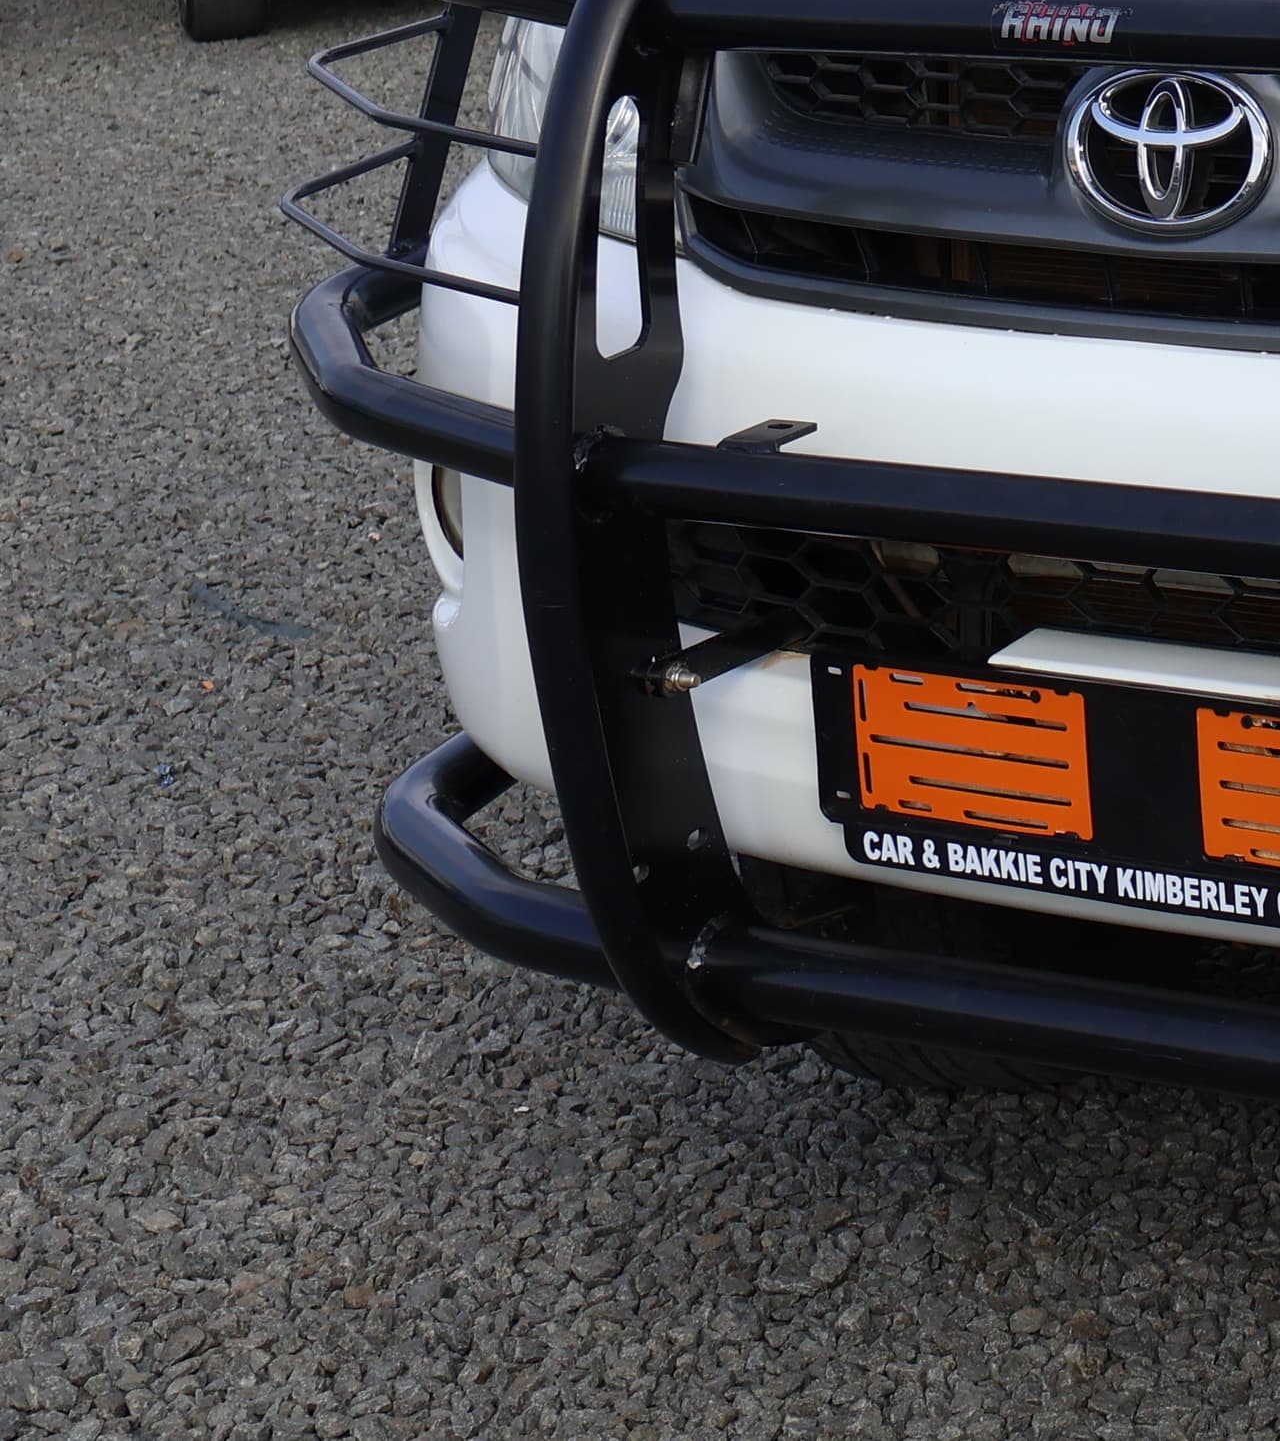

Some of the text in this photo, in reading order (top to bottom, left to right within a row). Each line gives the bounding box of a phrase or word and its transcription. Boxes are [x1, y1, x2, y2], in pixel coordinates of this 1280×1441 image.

[862, 829, 916, 868] CAR
[921, 839, 942, 871] &
[947, 842, 1044, 886] BAKKIE
[1050, 858, 1109, 896] CITY
[1115, 866, 1269, 920] KIMBERLEY
